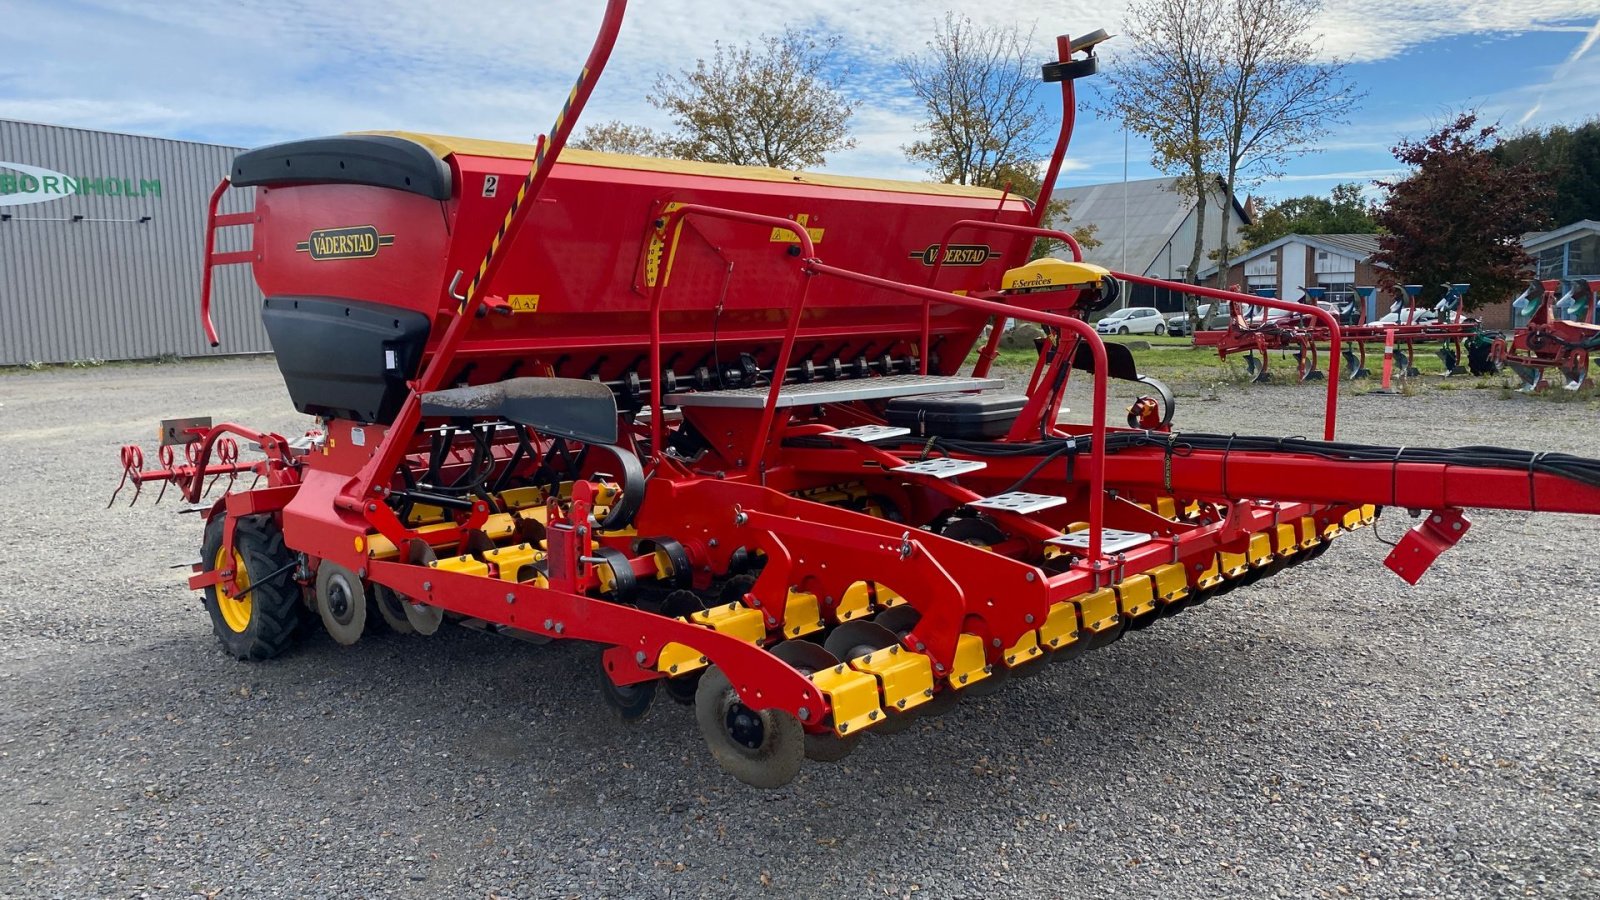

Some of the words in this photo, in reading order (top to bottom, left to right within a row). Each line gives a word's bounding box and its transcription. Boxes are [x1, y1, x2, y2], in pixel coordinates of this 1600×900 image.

[0, 174, 161, 198] BORNHOLM
[485, 176, 497, 193] 2
[313, 232, 374, 255] VÄDERSTAD
[929, 248, 985, 262] VDERSTAD
